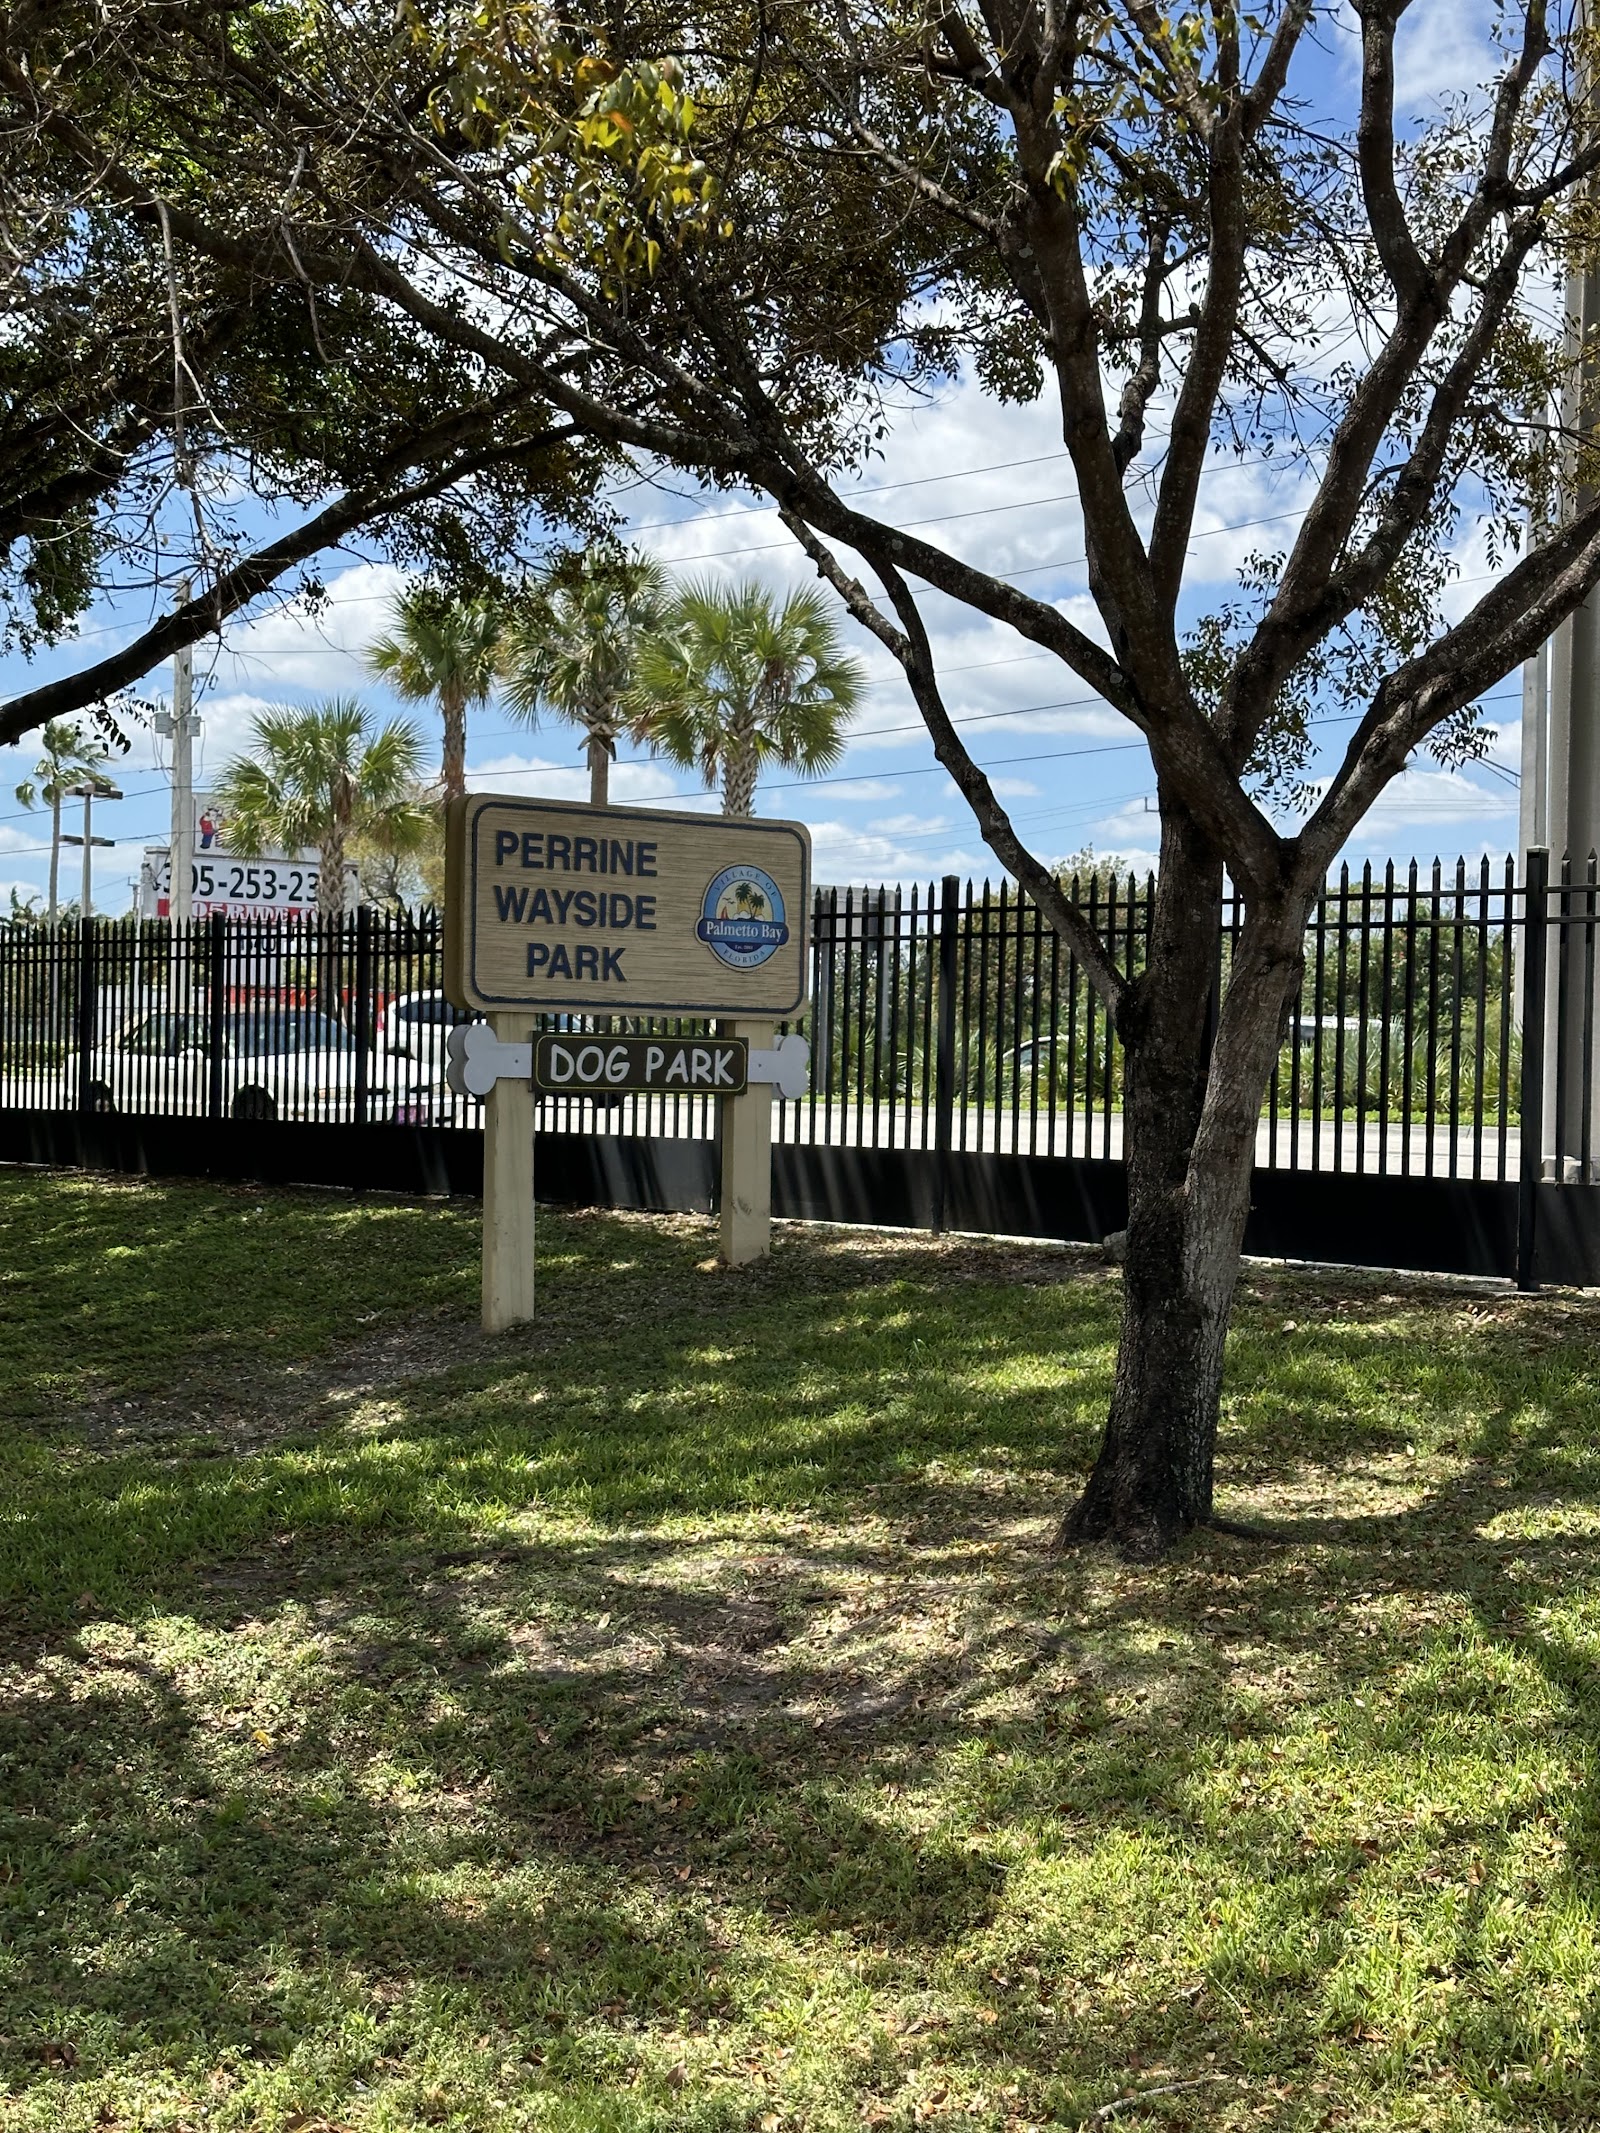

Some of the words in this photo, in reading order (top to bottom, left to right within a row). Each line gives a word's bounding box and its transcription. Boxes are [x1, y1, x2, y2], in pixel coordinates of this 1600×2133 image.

[494, 830, 658, 877] PERRINE
[713, 870, 761, 891] VILLAGE
[765, 882, 778, 897] OF
[493, 885, 657, 930] WAYSIDE
[706, 921, 758, 938] Palmetto
[761, 924, 783, 943] Bay
[526, 942, 628, 982] PARK
[722, 949, 766, 964] FLORIDA
[550, 1044, 631, 1083] DOG
[645, 1048, 735, 1085] PARK
